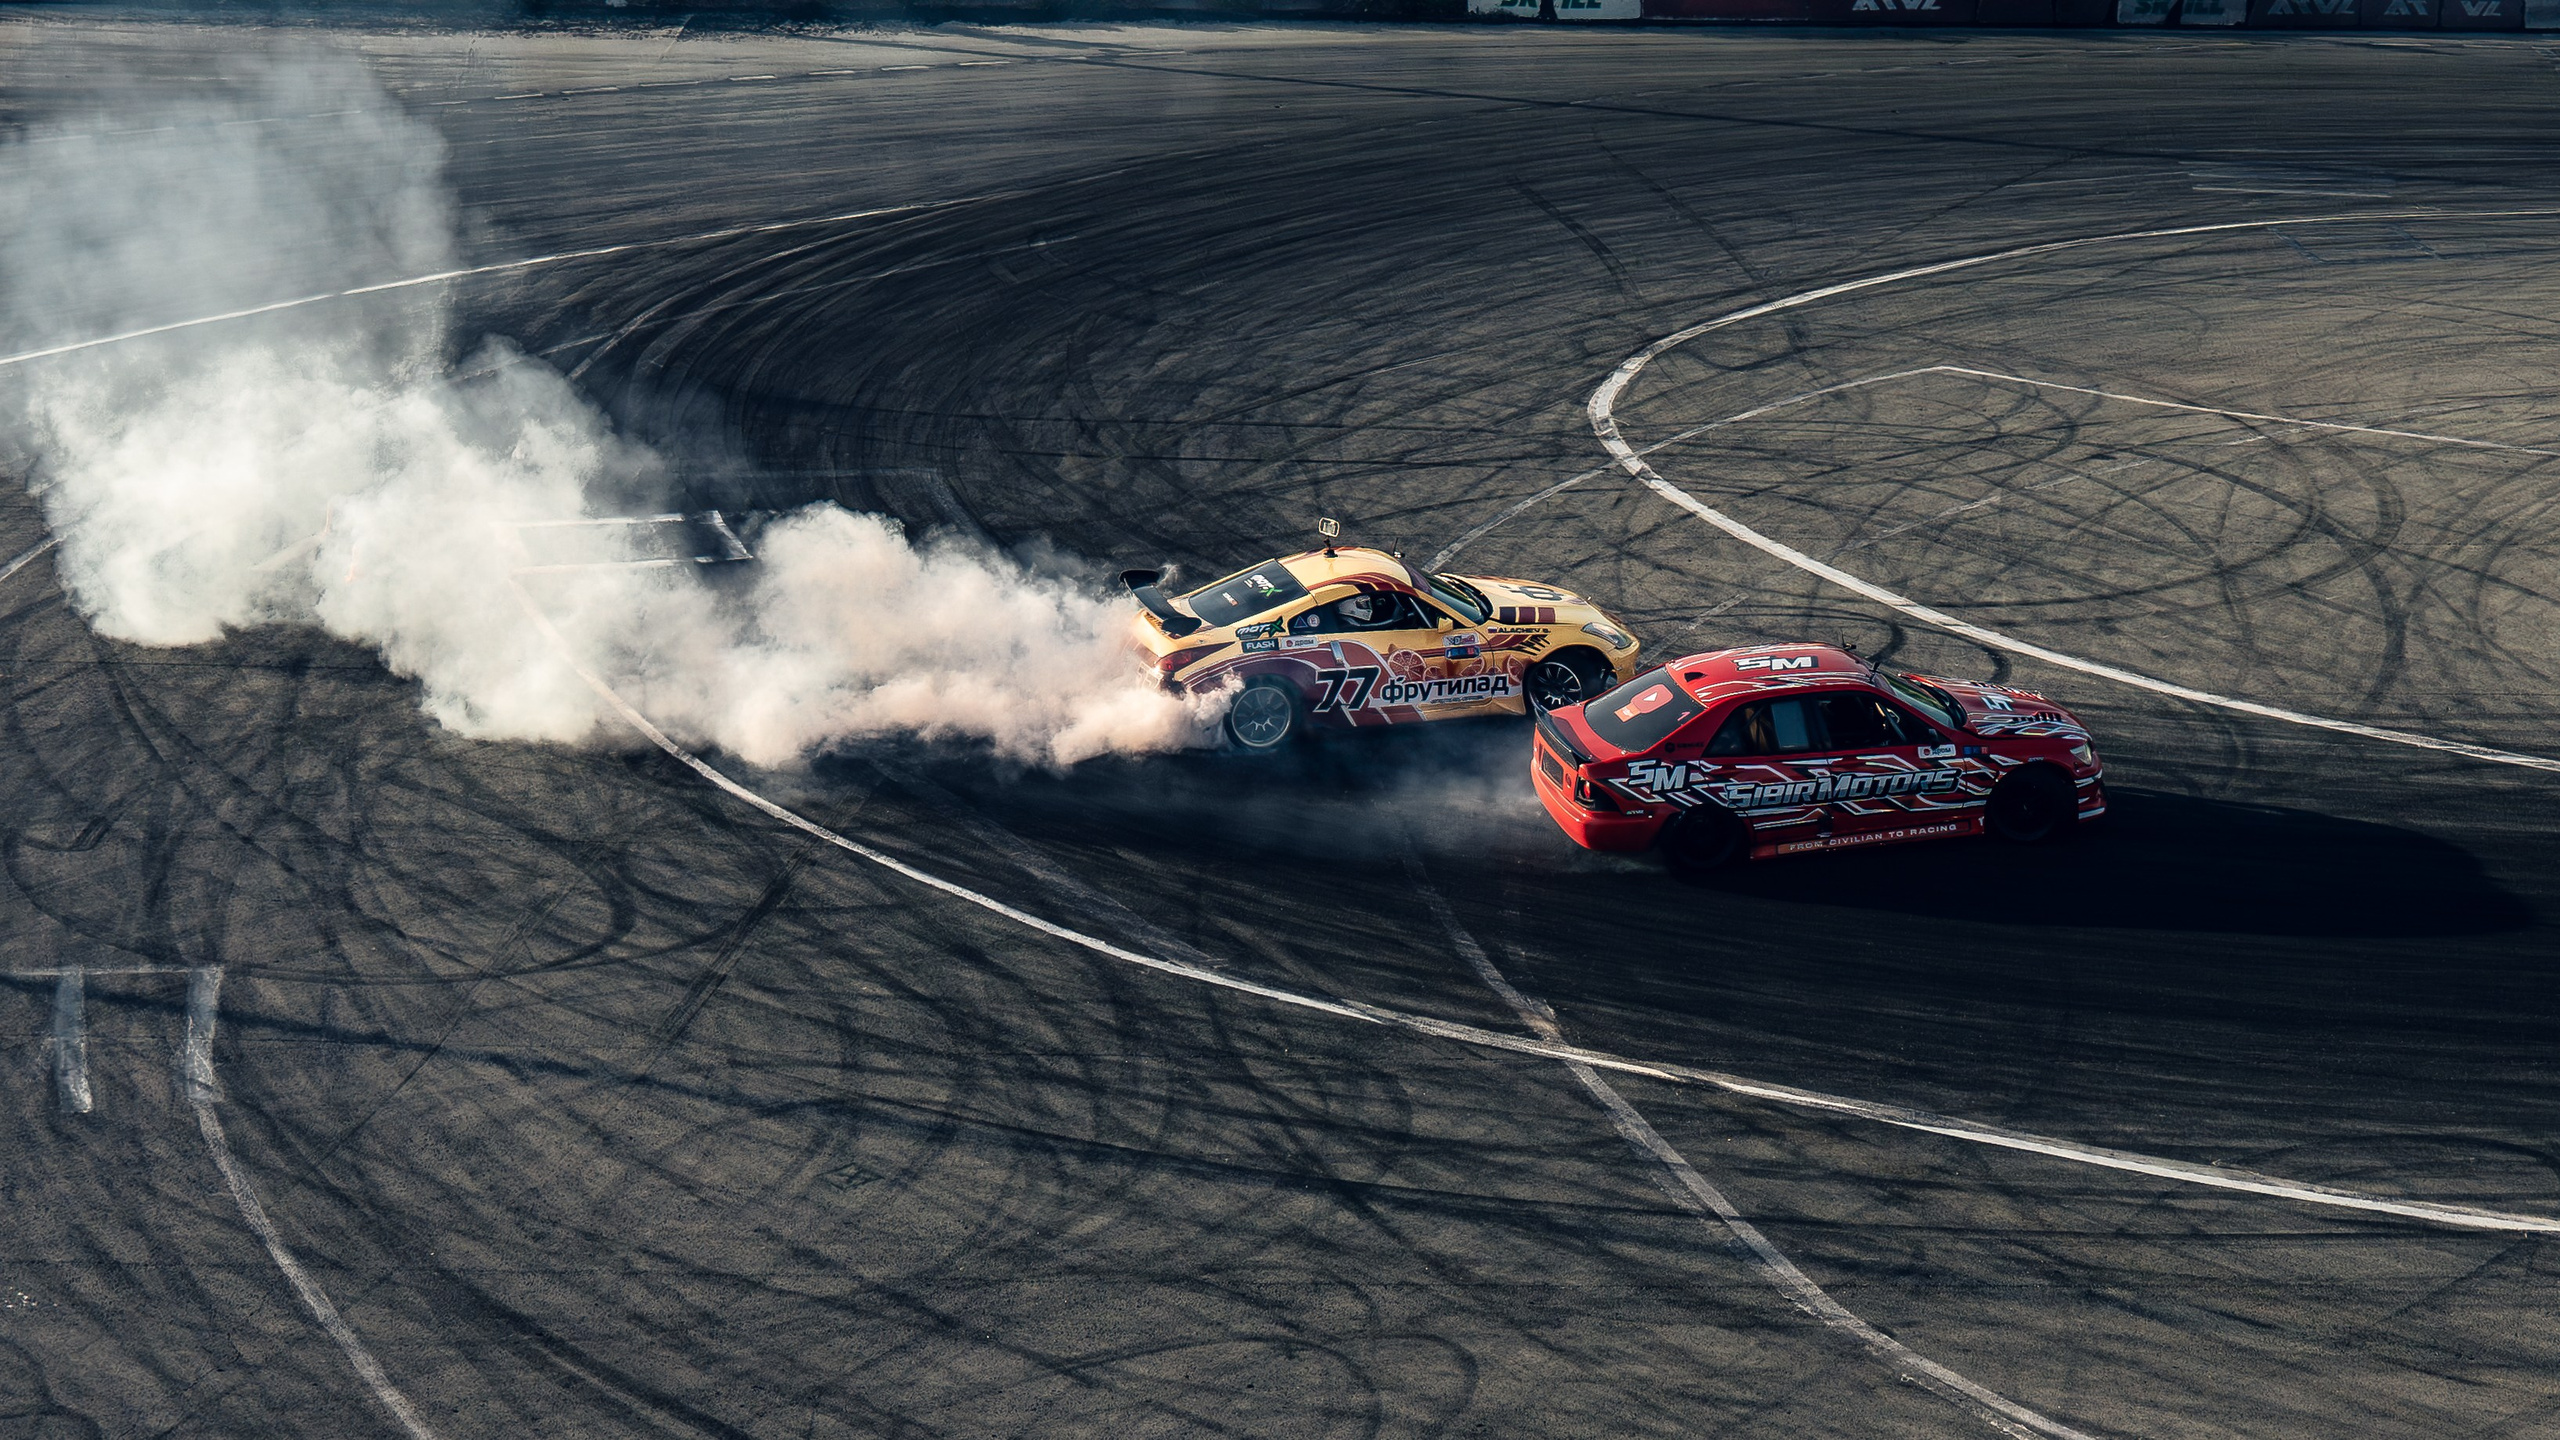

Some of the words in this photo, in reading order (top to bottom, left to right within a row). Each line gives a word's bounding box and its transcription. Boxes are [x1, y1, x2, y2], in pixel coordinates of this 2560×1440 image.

[1246, 641, 1275, 650] FLASH
[1734, 656, 1812, 671] SM
[1313, 665, 1380, 712] 77
[1628, 760, 1686, 791] SM
[1790, 841, 1823, 851] FROM
[1829, 834, 1882, 846] CIVILIAN
[1889, 830, 1904, 838] TO
[1910, 824, 1957, 836] RACING
